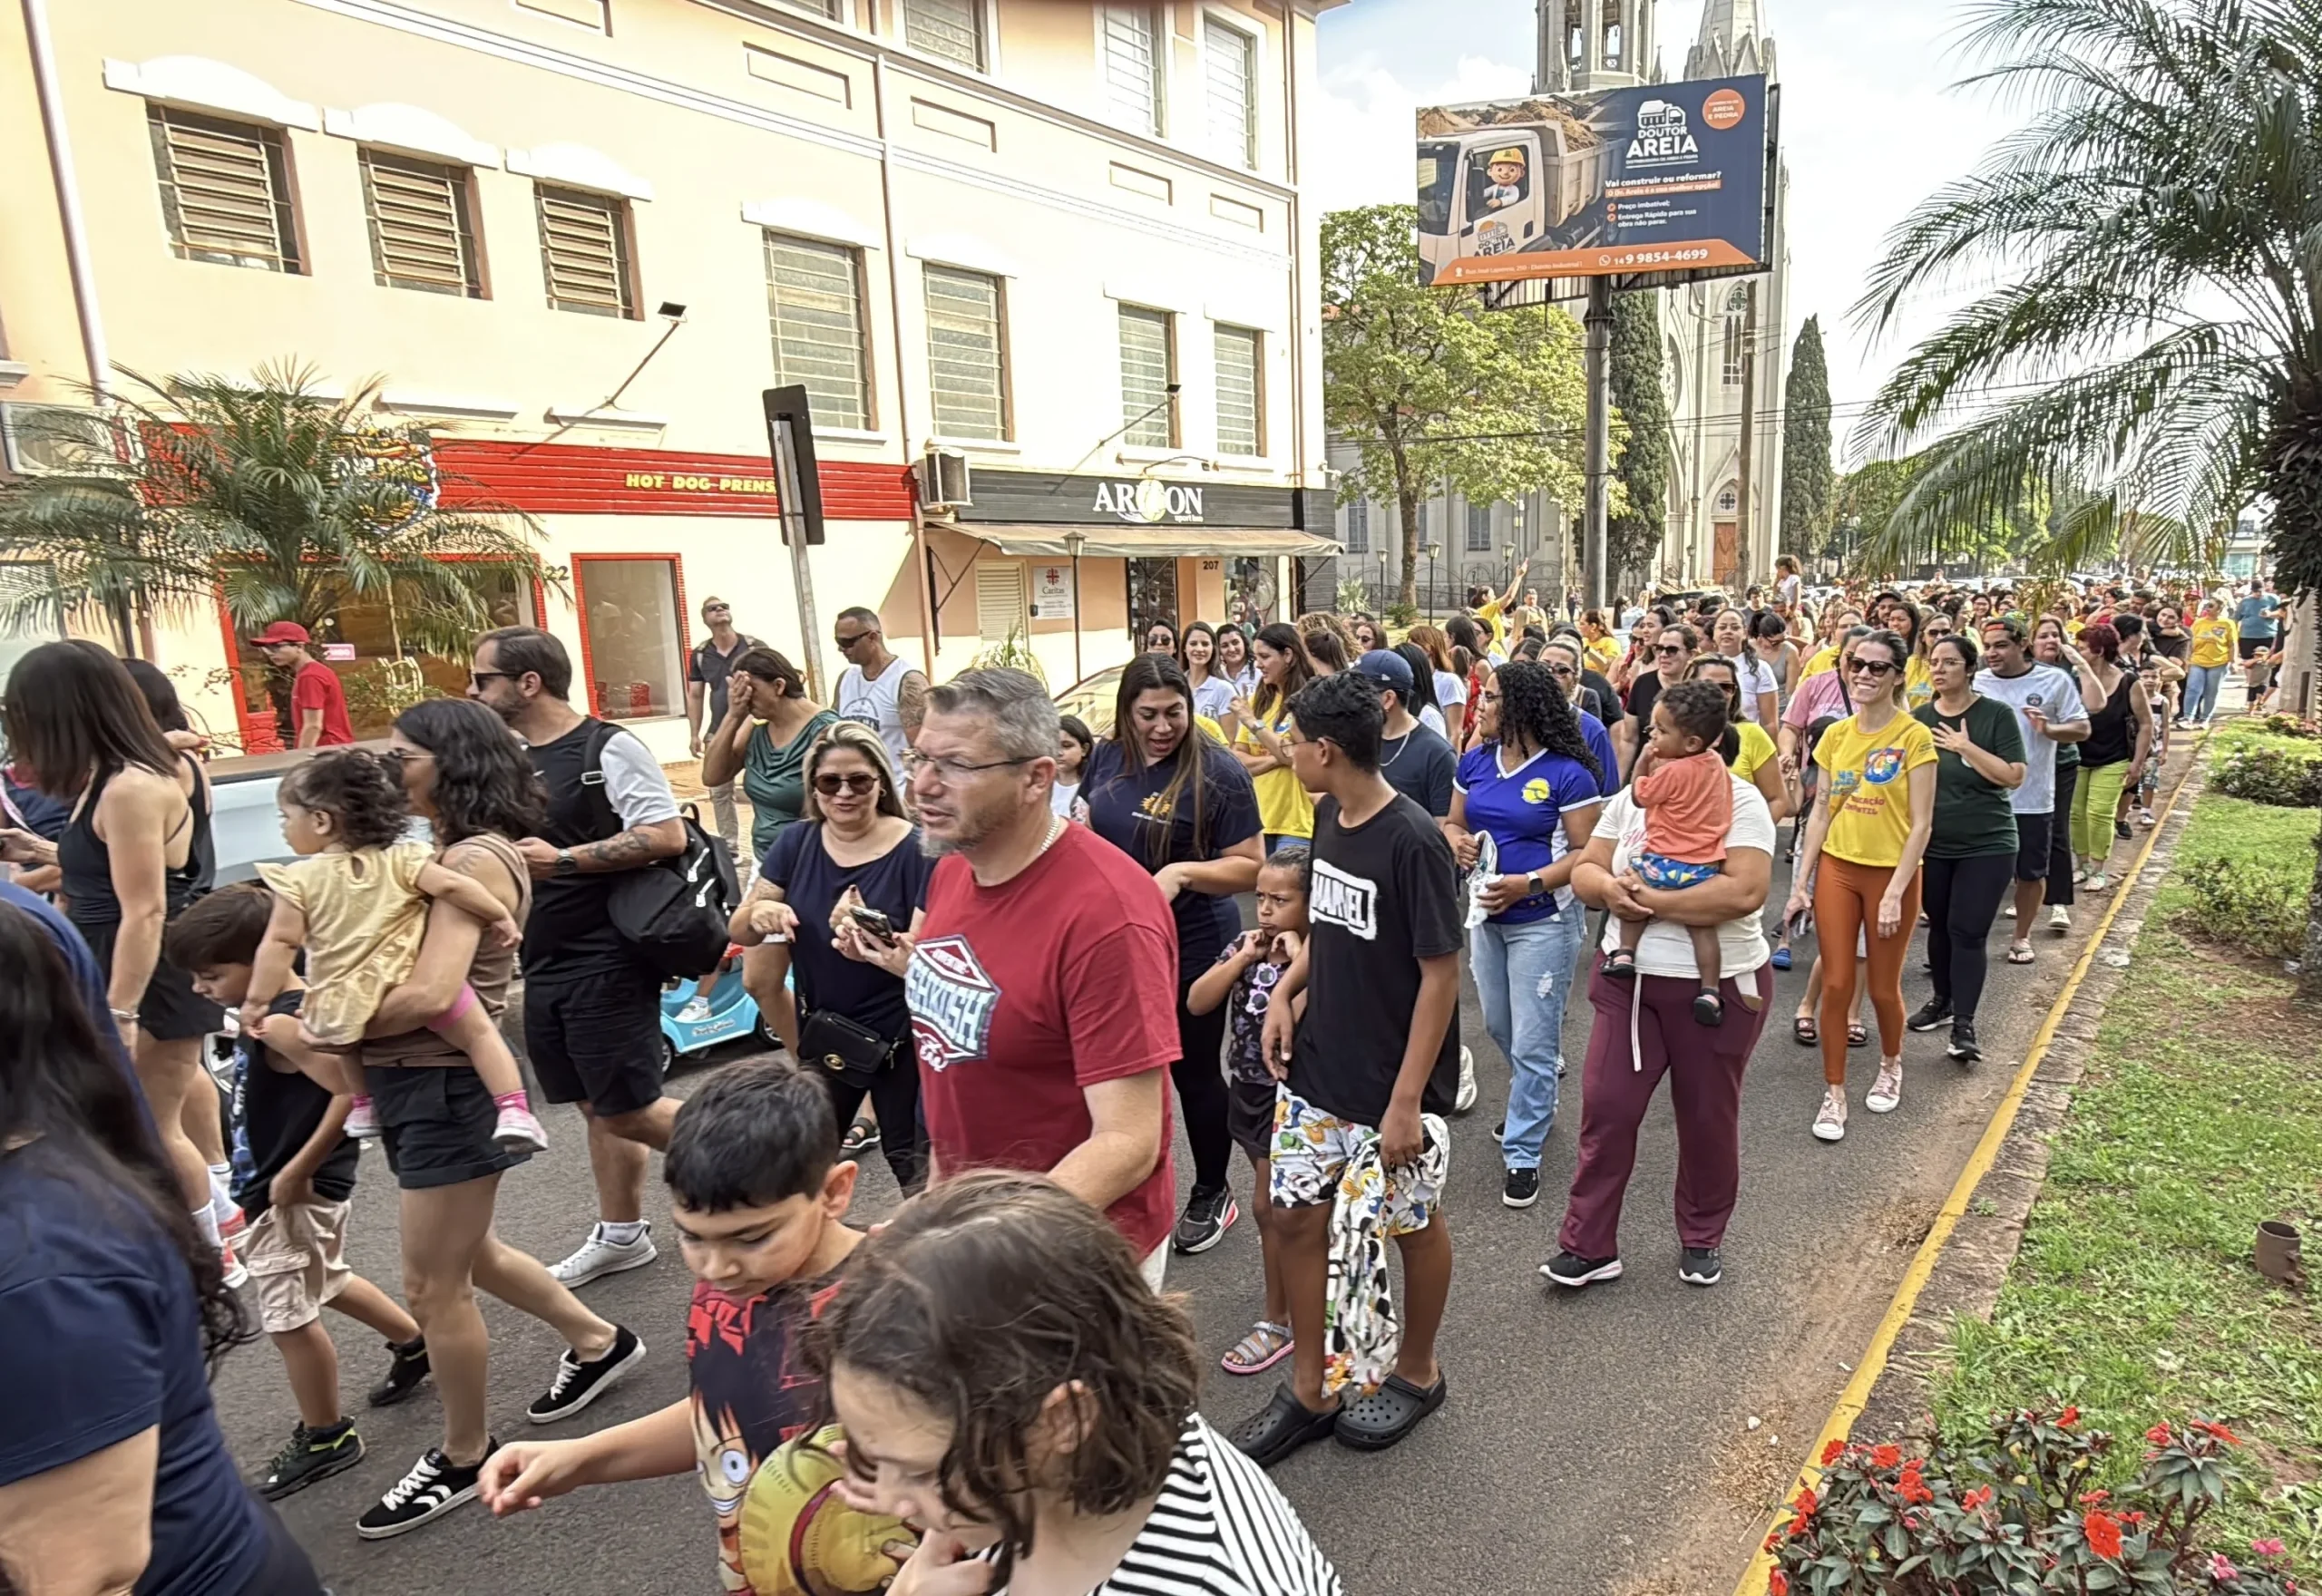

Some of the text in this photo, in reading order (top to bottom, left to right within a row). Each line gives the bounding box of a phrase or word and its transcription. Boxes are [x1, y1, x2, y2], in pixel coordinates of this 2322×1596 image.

[1713, 112, 1739, 120] PEDRA
[1637, 126, 1688, 139] DOUTOR
[1625, 134, 1699, 159] AREIA
[1605, 180, 1619, 188] Vai
[1621, 176, 1662, 187] construir
[1676, 170, 1722, 182] reformar?
[1615, 189, 1624, 197] Dr.
[1625, 187, 1644, 195] Areia
[1617, 201, 1636, 210] Preço
[1644, 210, 1667, 219] Rápida
[1668, 209, 1683, 218] para
[1647, 219, 1667, 227] parar.
[1636, 248, 1708, 264] 9854-4699
[626, 473, 776, 493] HOT DOG PRENS
[1203, 560, 1219, 570] 207
